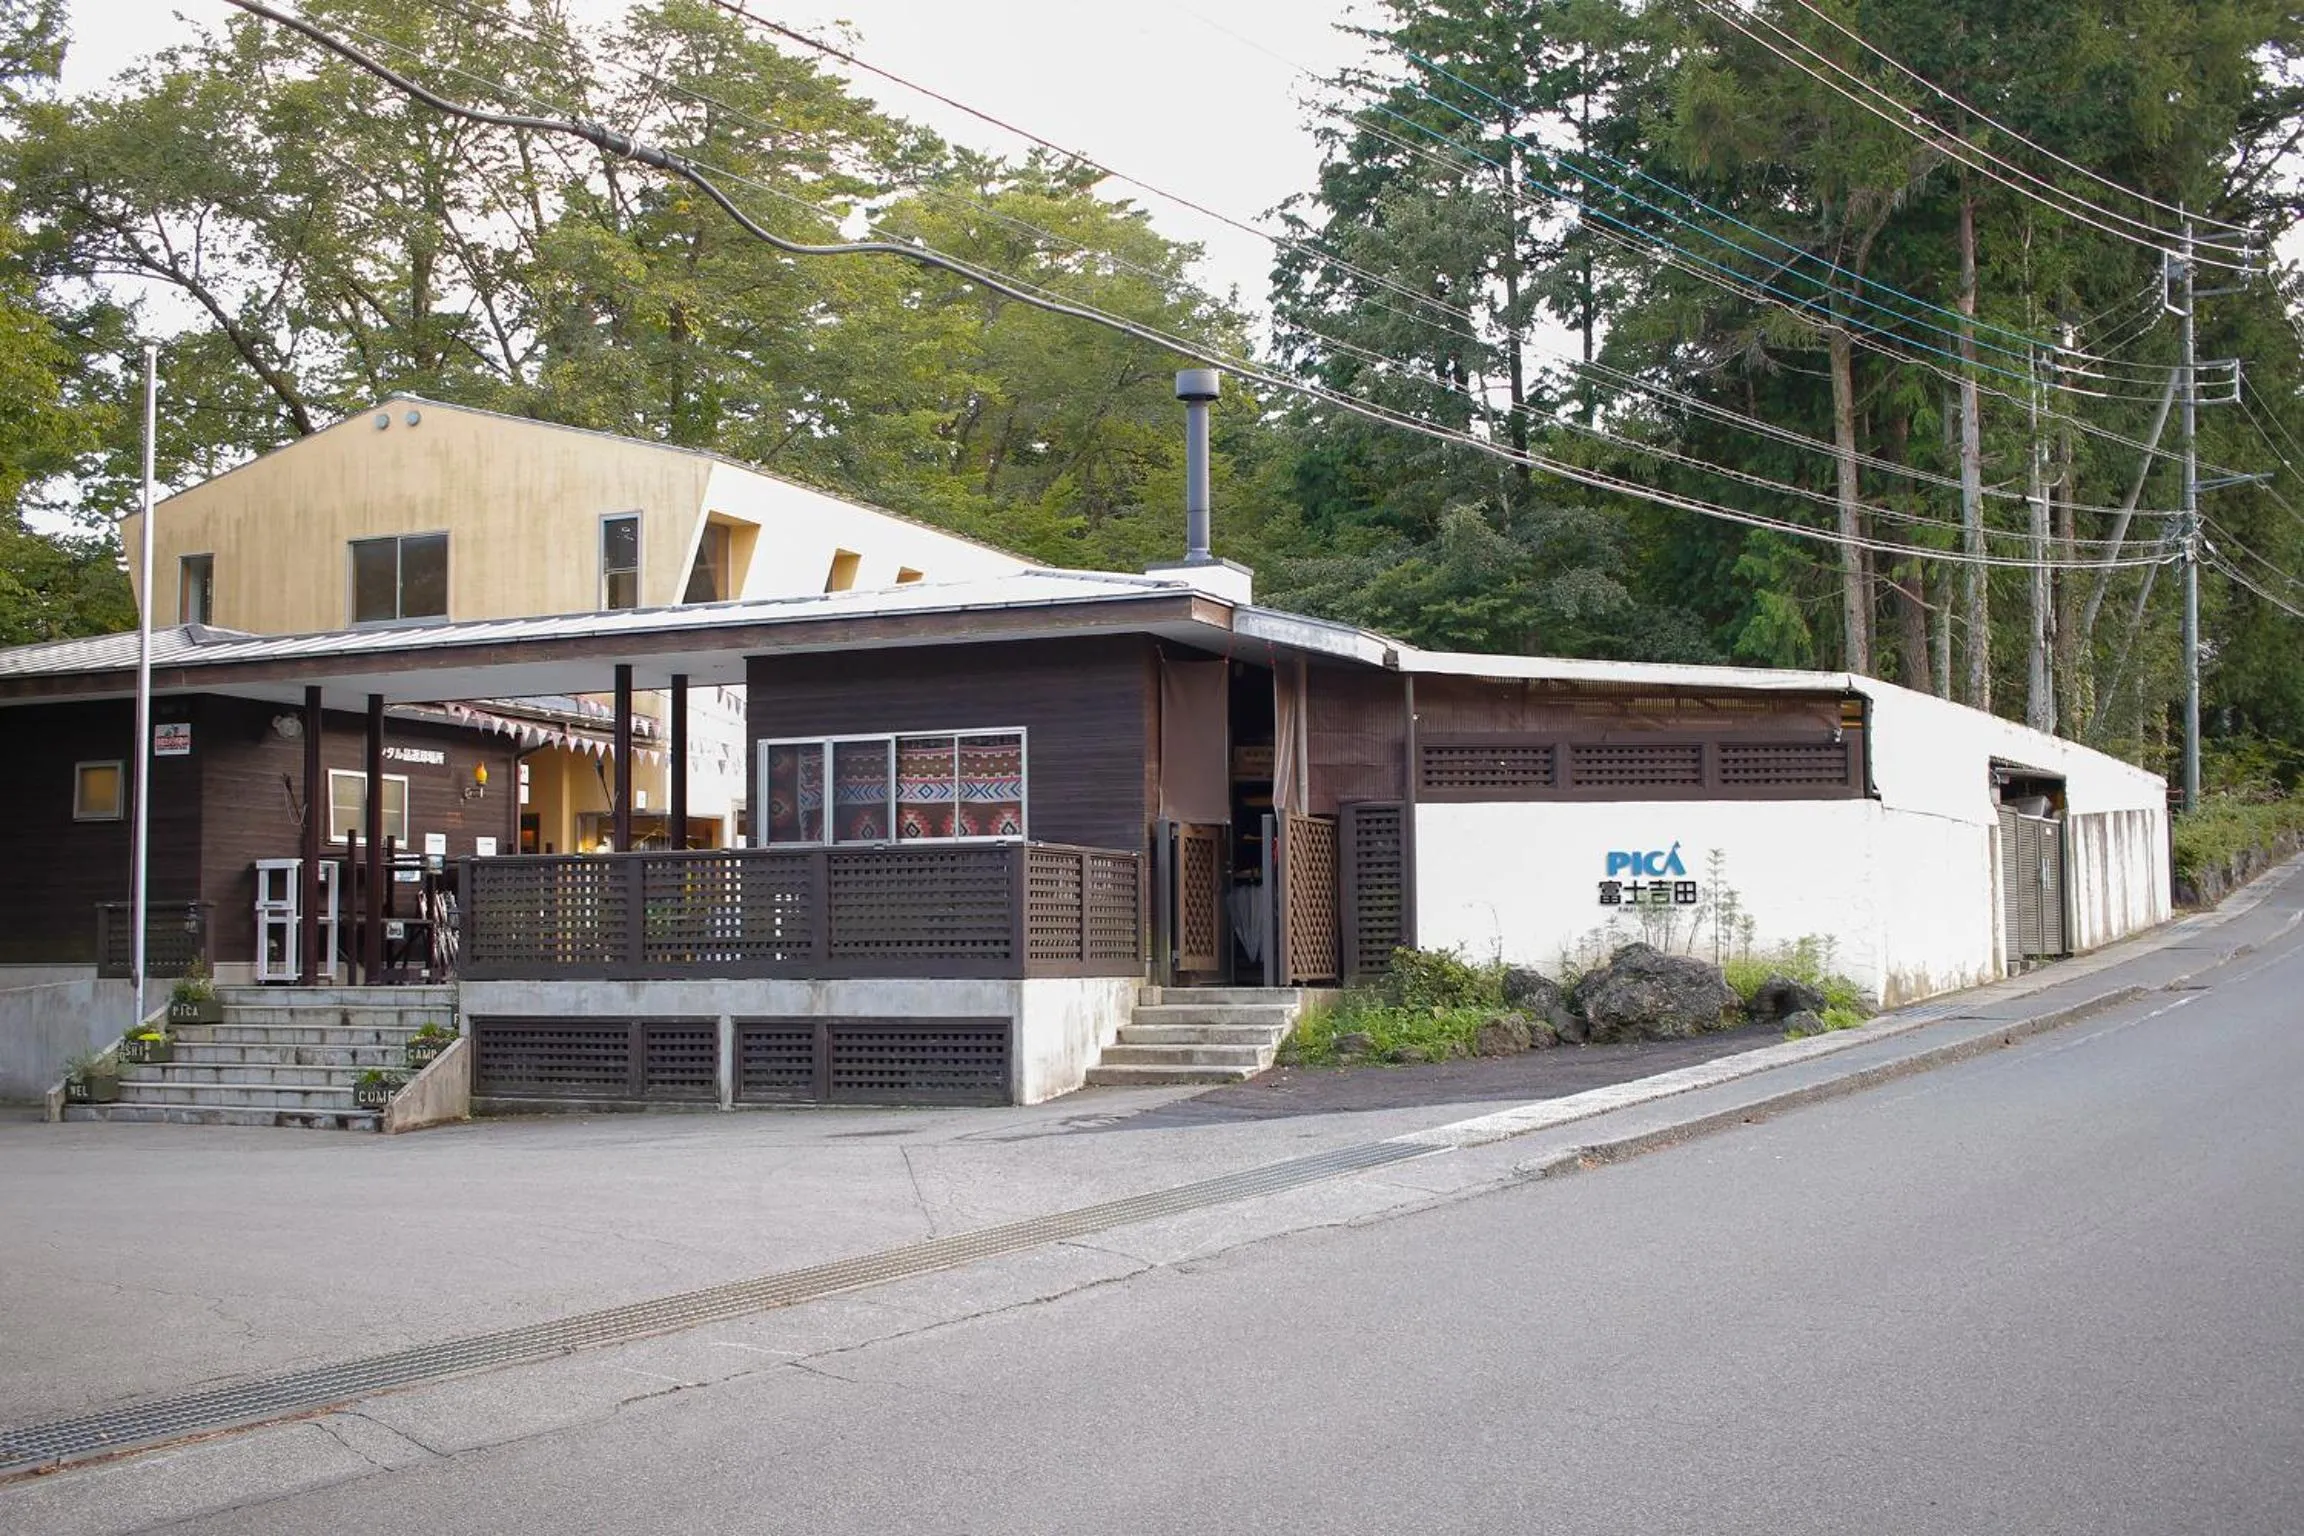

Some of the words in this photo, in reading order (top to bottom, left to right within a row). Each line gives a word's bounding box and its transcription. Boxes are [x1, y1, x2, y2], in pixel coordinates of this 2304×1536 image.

[1607, 841, 1687, 877] PICA
[1599, 880, 1697, 904] 富士吉田
[172, 1004, 199, 1017] PICA
